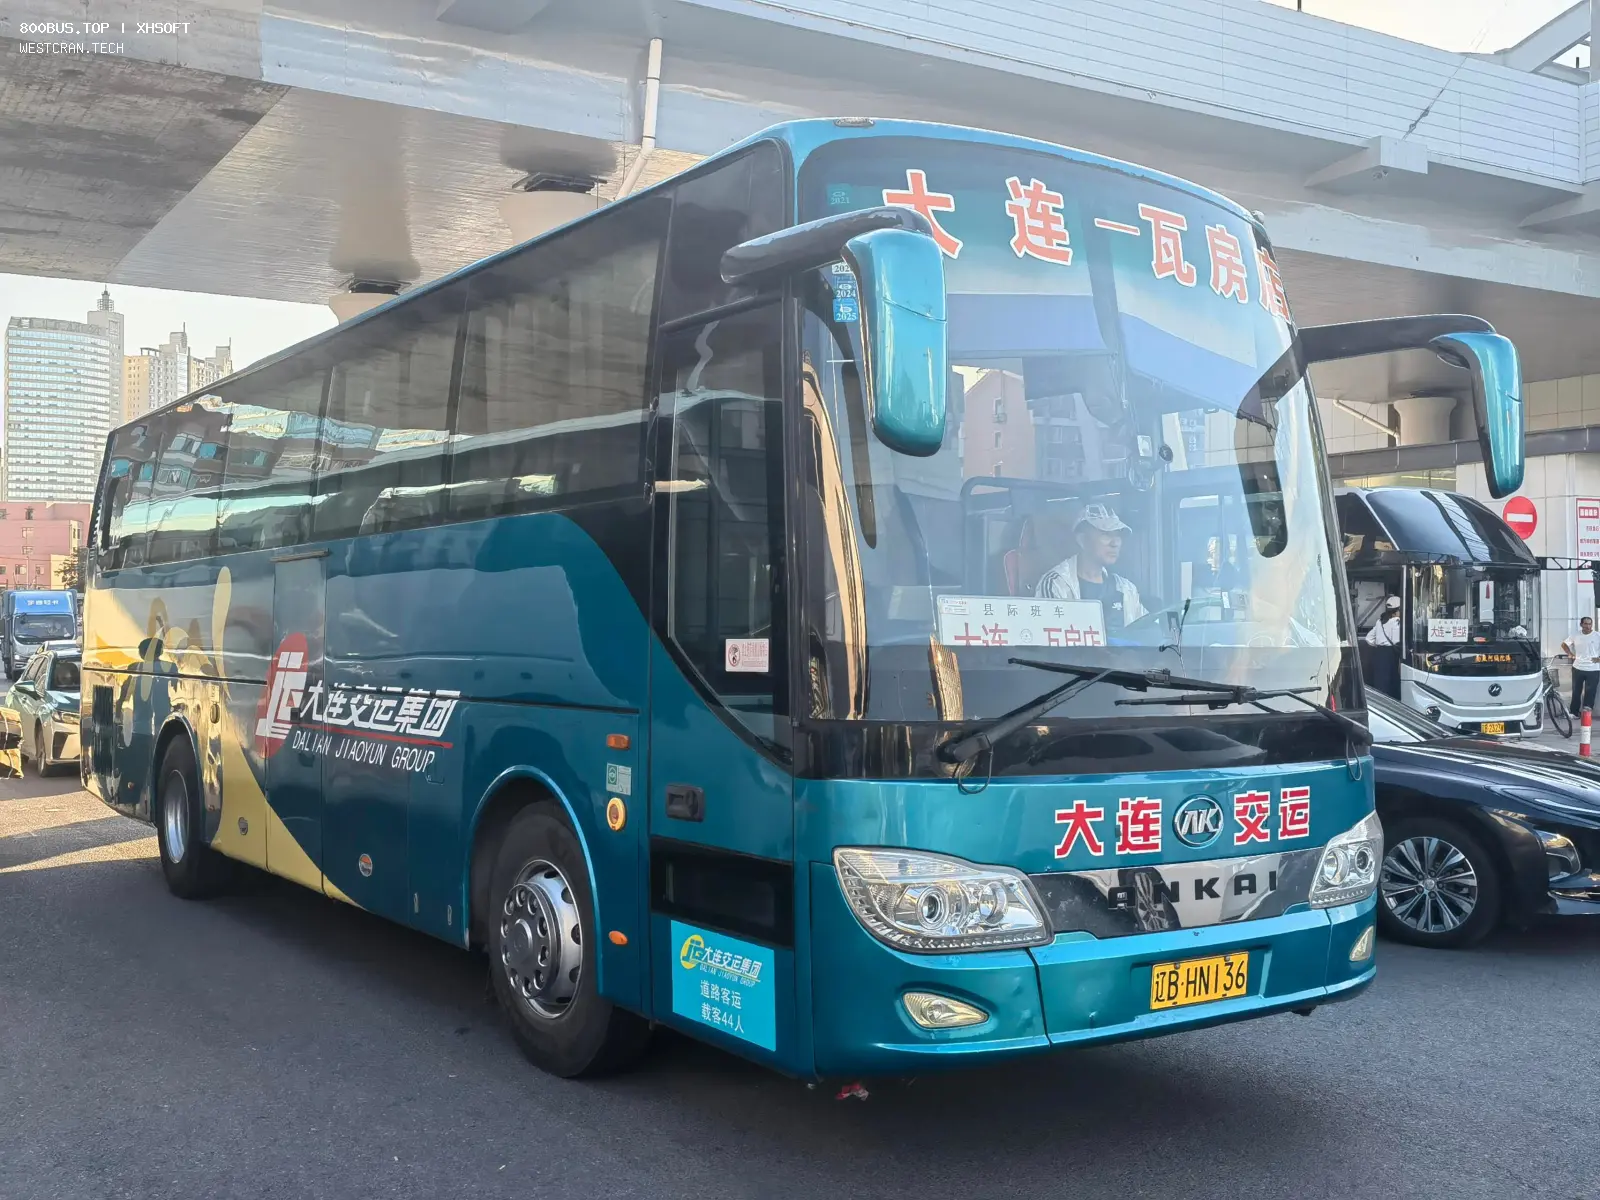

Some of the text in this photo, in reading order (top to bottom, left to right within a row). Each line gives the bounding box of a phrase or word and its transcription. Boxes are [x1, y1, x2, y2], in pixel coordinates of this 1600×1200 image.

[836, 289, 856, 298] 2024
[836, 312, 857, 321] 2025
[983, 603, 1065, 618] 县际班车
[301, 679, 461, 738] 大连交运集团
[292, 730, 436, 773] DALIAN JIAOYUN GROUP
[702, 946, 763, 979] 大连交运集团
[700, 979, 742, 1009] 道路客运
[702, 1001, 744, 1034] 载客44人
